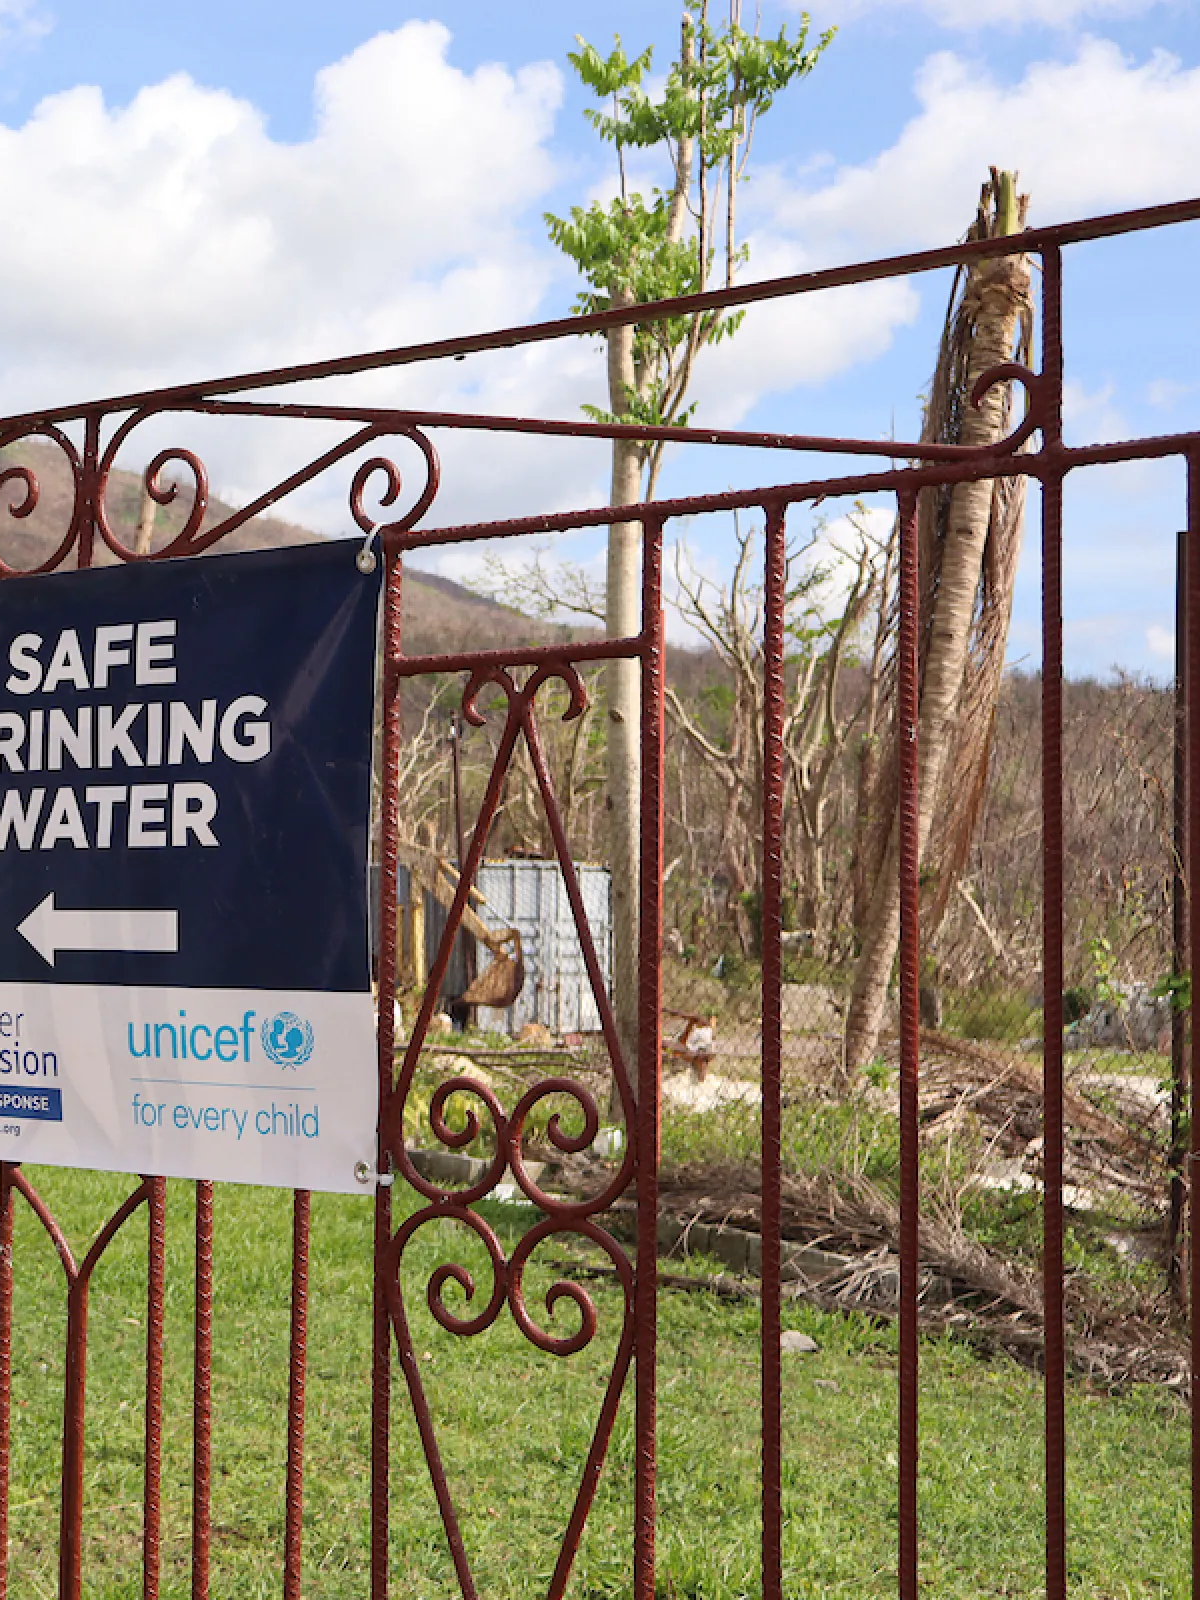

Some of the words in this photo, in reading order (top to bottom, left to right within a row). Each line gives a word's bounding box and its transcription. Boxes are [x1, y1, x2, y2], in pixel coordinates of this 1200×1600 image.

[6, 620, 177, 694] SAFE
[127, 1009, 256, 1063] unicef
[132, 1094, 166, 1128] for
[172, 1104, 247, 1141] every
[255, 1102, 320, 1138] child
